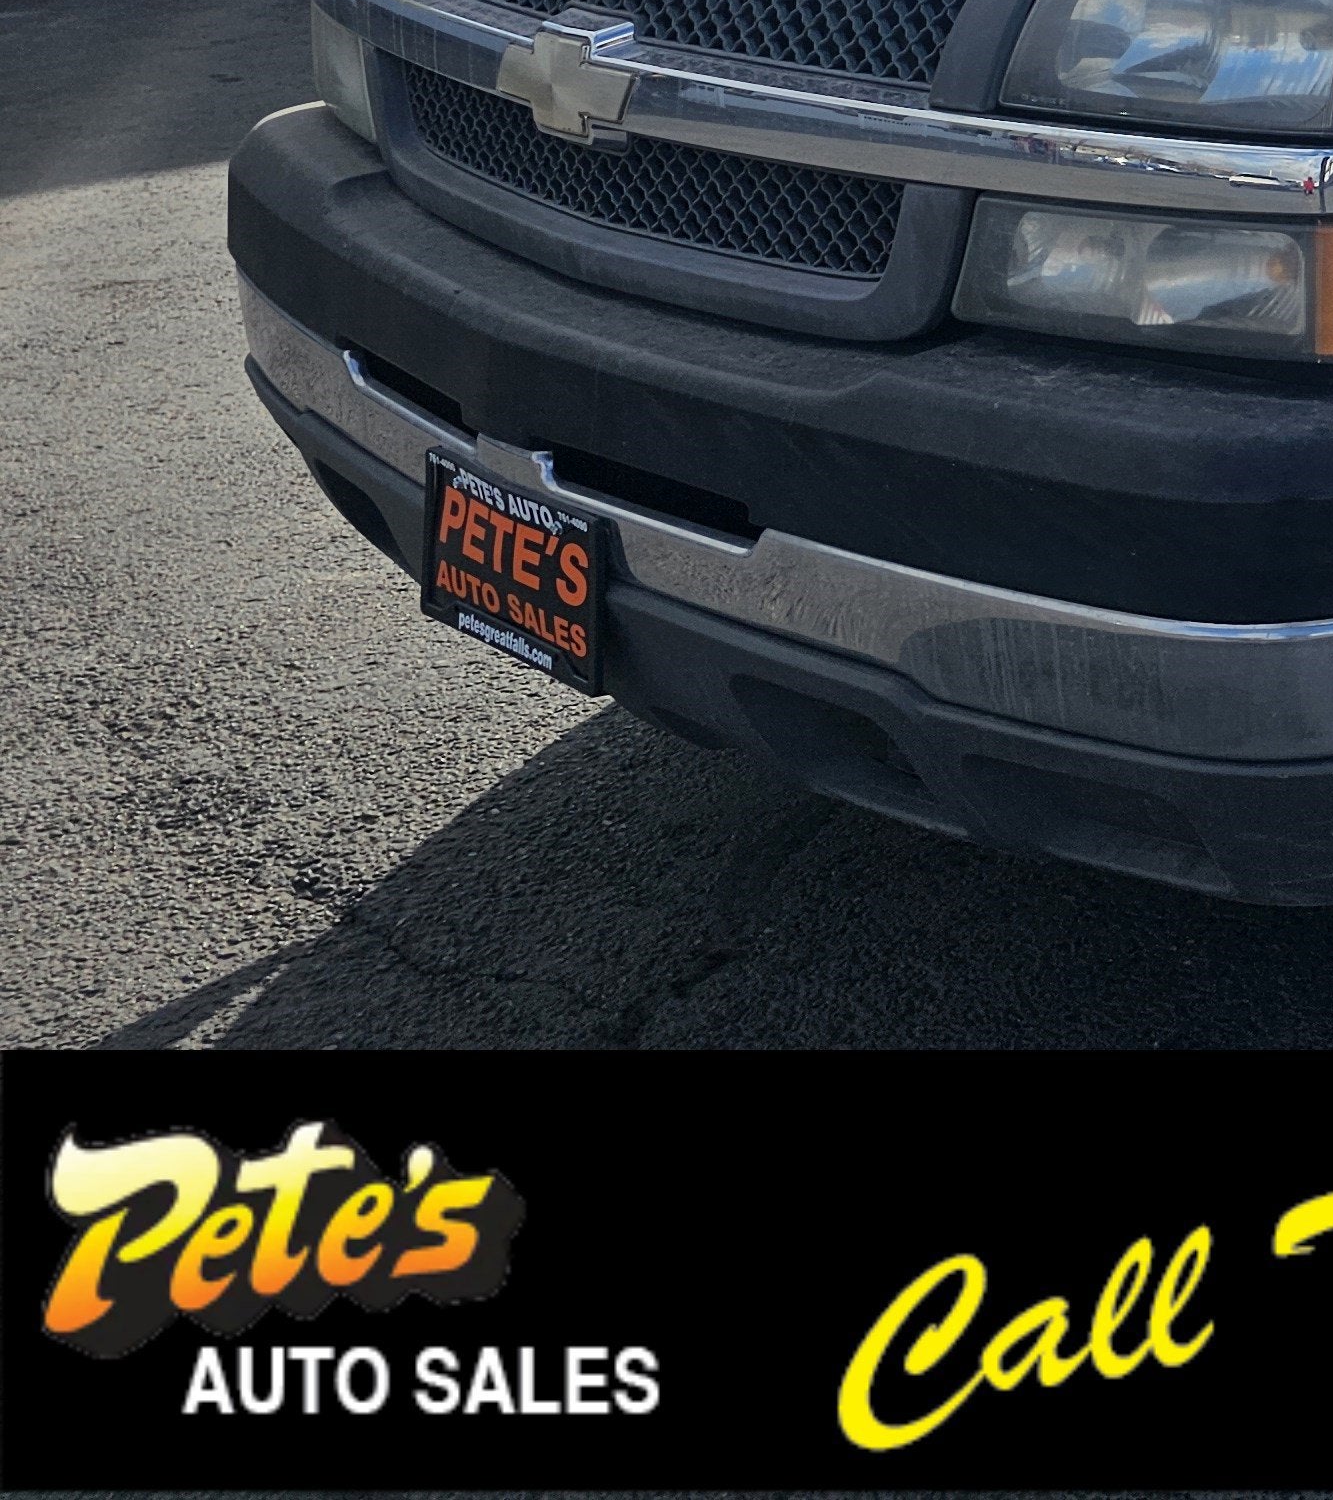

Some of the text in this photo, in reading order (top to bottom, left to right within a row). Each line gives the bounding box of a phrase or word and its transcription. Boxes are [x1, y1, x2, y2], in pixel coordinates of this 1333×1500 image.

[459, 467, 553, 530] PETE'S AUTO
[439, 485, 589, 607] PETE'S
[436, 559, 587, 657] AUTO SALES
[458, 612, 552, 670] petesgreatfalls.com
